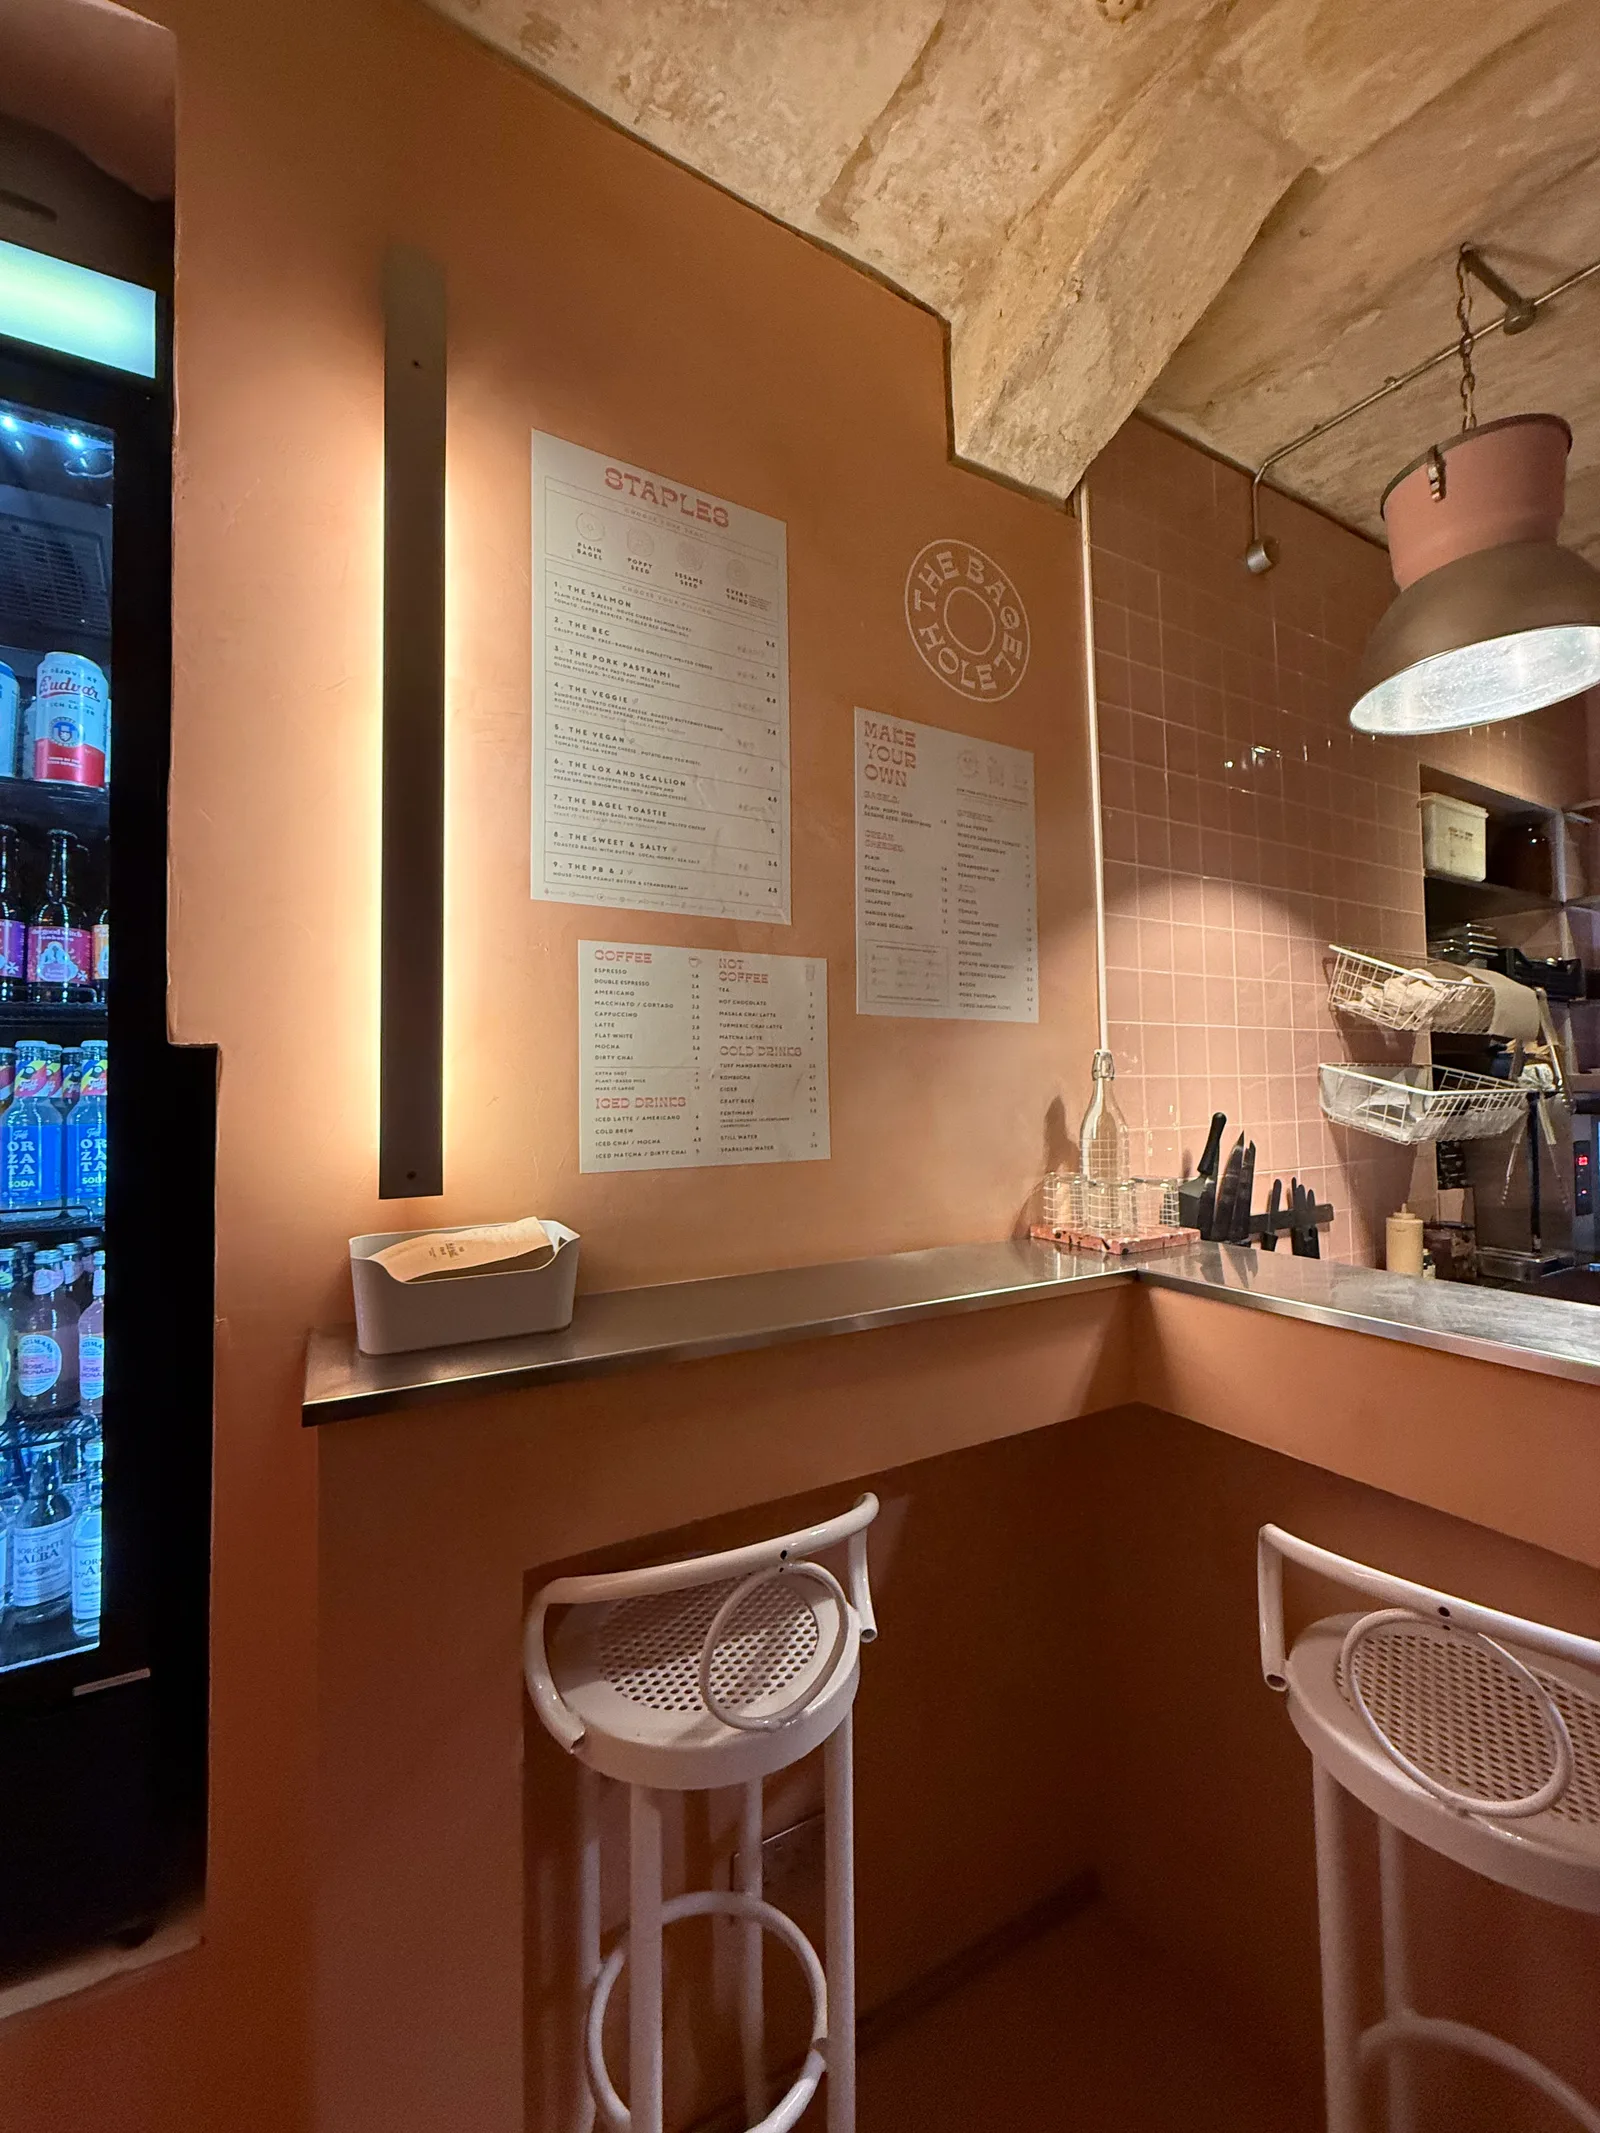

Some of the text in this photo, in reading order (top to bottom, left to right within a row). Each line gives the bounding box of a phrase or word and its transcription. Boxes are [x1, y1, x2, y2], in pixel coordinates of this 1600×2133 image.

[605, 465, 729, 530] STAPLES
[576, 548, 603, 561] BAGEL
[577, 541, 602, 554] PLAIN
[627, 556, 653, 570] POPPY
[630, 564, 650, 576] SEED
[674, 571, 703, 585] SESAME
[680, 579, 698, 590] SEED
[567, 584, 586, 596] THE
[591, 591, 631, 609] SALMON
[569, 620, 587, 631] THE
[592, 626, 610, 637] BEC
[914, 551, 1023, 691] THE BAGEL HOLE
[569, 648, 588, 659] THE
[593, 654, 618, 667] PORK
[623, 661, 671, 680] PASTRAMI
[569, 685, 587, 695] THE
[592, 690, 628, 704] VEGGIE
[569, 726, 588, 736] THE
[593, 731, 625, 744] VEGAN
[864, 720, 916, 749] MAKE
[865, 742, 916, 770] YOUR
[569, 760, 587, 770] THE
[592, 764, 611, 774] LOX
[616, 769, 636, 778] AND
[640, 773, 686, 788] SCALLION
[865, 763, 907, 788] OWN
[568, 796, 586, 805] THE
[592, 800, 623, 811] BAGEL
[627, 805, 667, 818] TOASTIE
[569, 833, 588, 841] THE
[592, 836, 625, 847] SWEET
[640, 843, 668, 853] SALTY
[568, 863, 587, 871] THE
[594, 949, 652, 964] COFFEE
[719, 958, 744, 970] NOT
[719, 971, 768, 984] COFFEE
[720, 1046, 802, 1057] COLD DRINKS
[595, 1097, 686, 1109] ICED DRINKS
[8, 1180, 35, 1188] SODA
